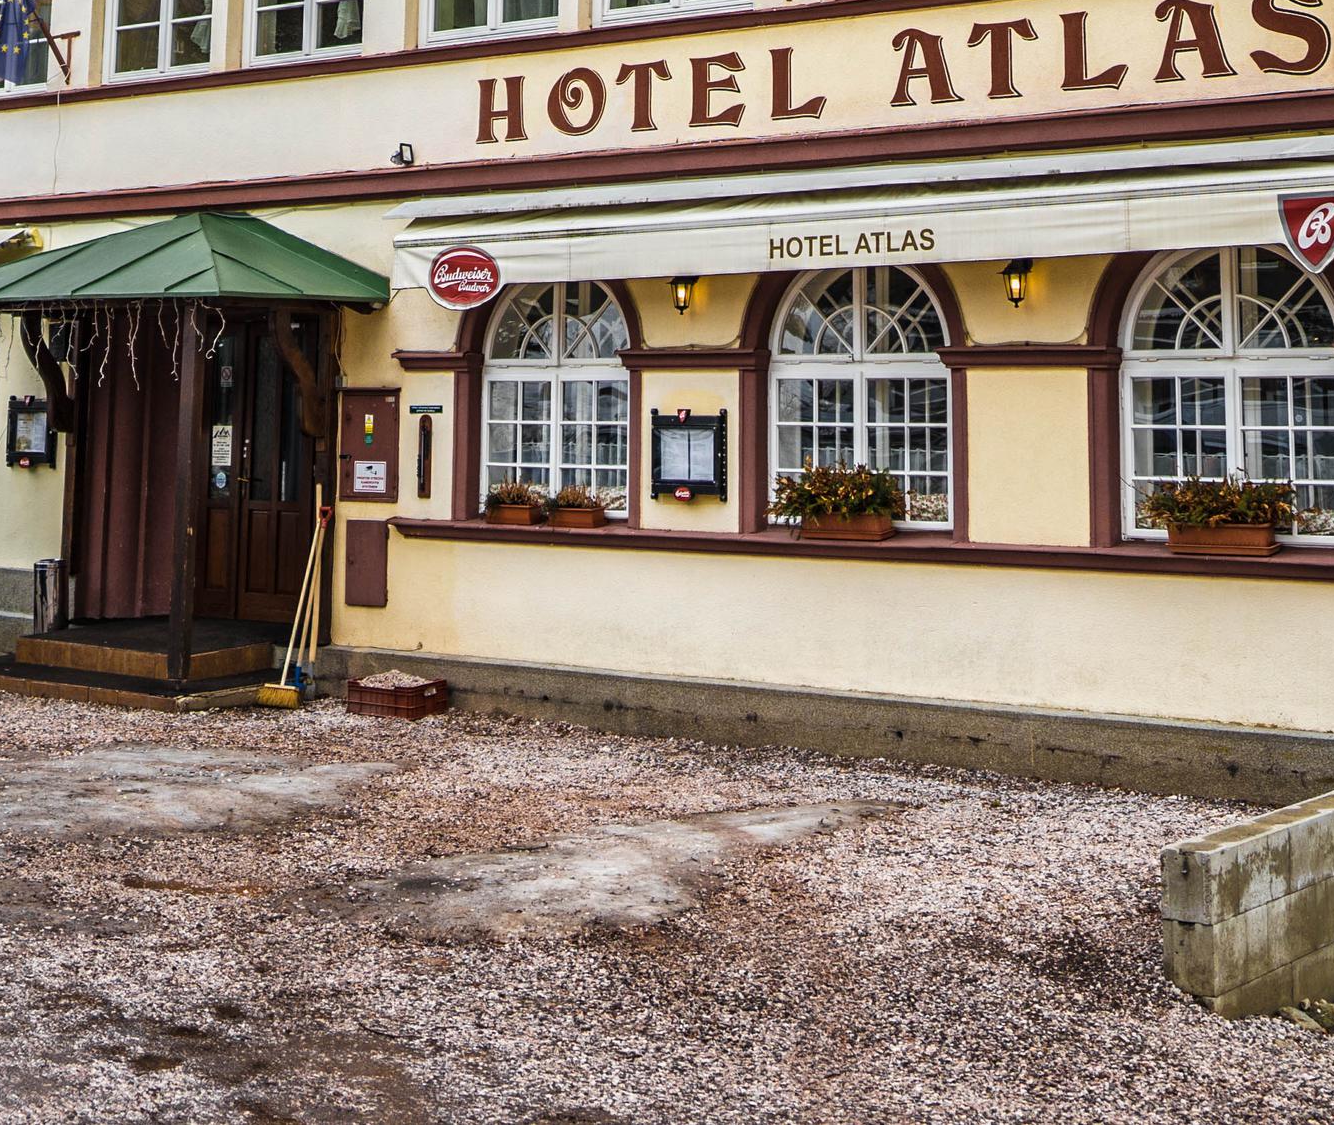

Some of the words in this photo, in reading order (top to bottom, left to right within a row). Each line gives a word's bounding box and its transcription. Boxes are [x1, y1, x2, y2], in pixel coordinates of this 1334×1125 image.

[475, 46, 827, 145] HOTEL
[769, 234, 848, 260] HOTEL
[854, 228, 935, 255] ATLAS
[433, 263, 494, 285] Budweiser
[457, 278, 492, 293] Budvar
